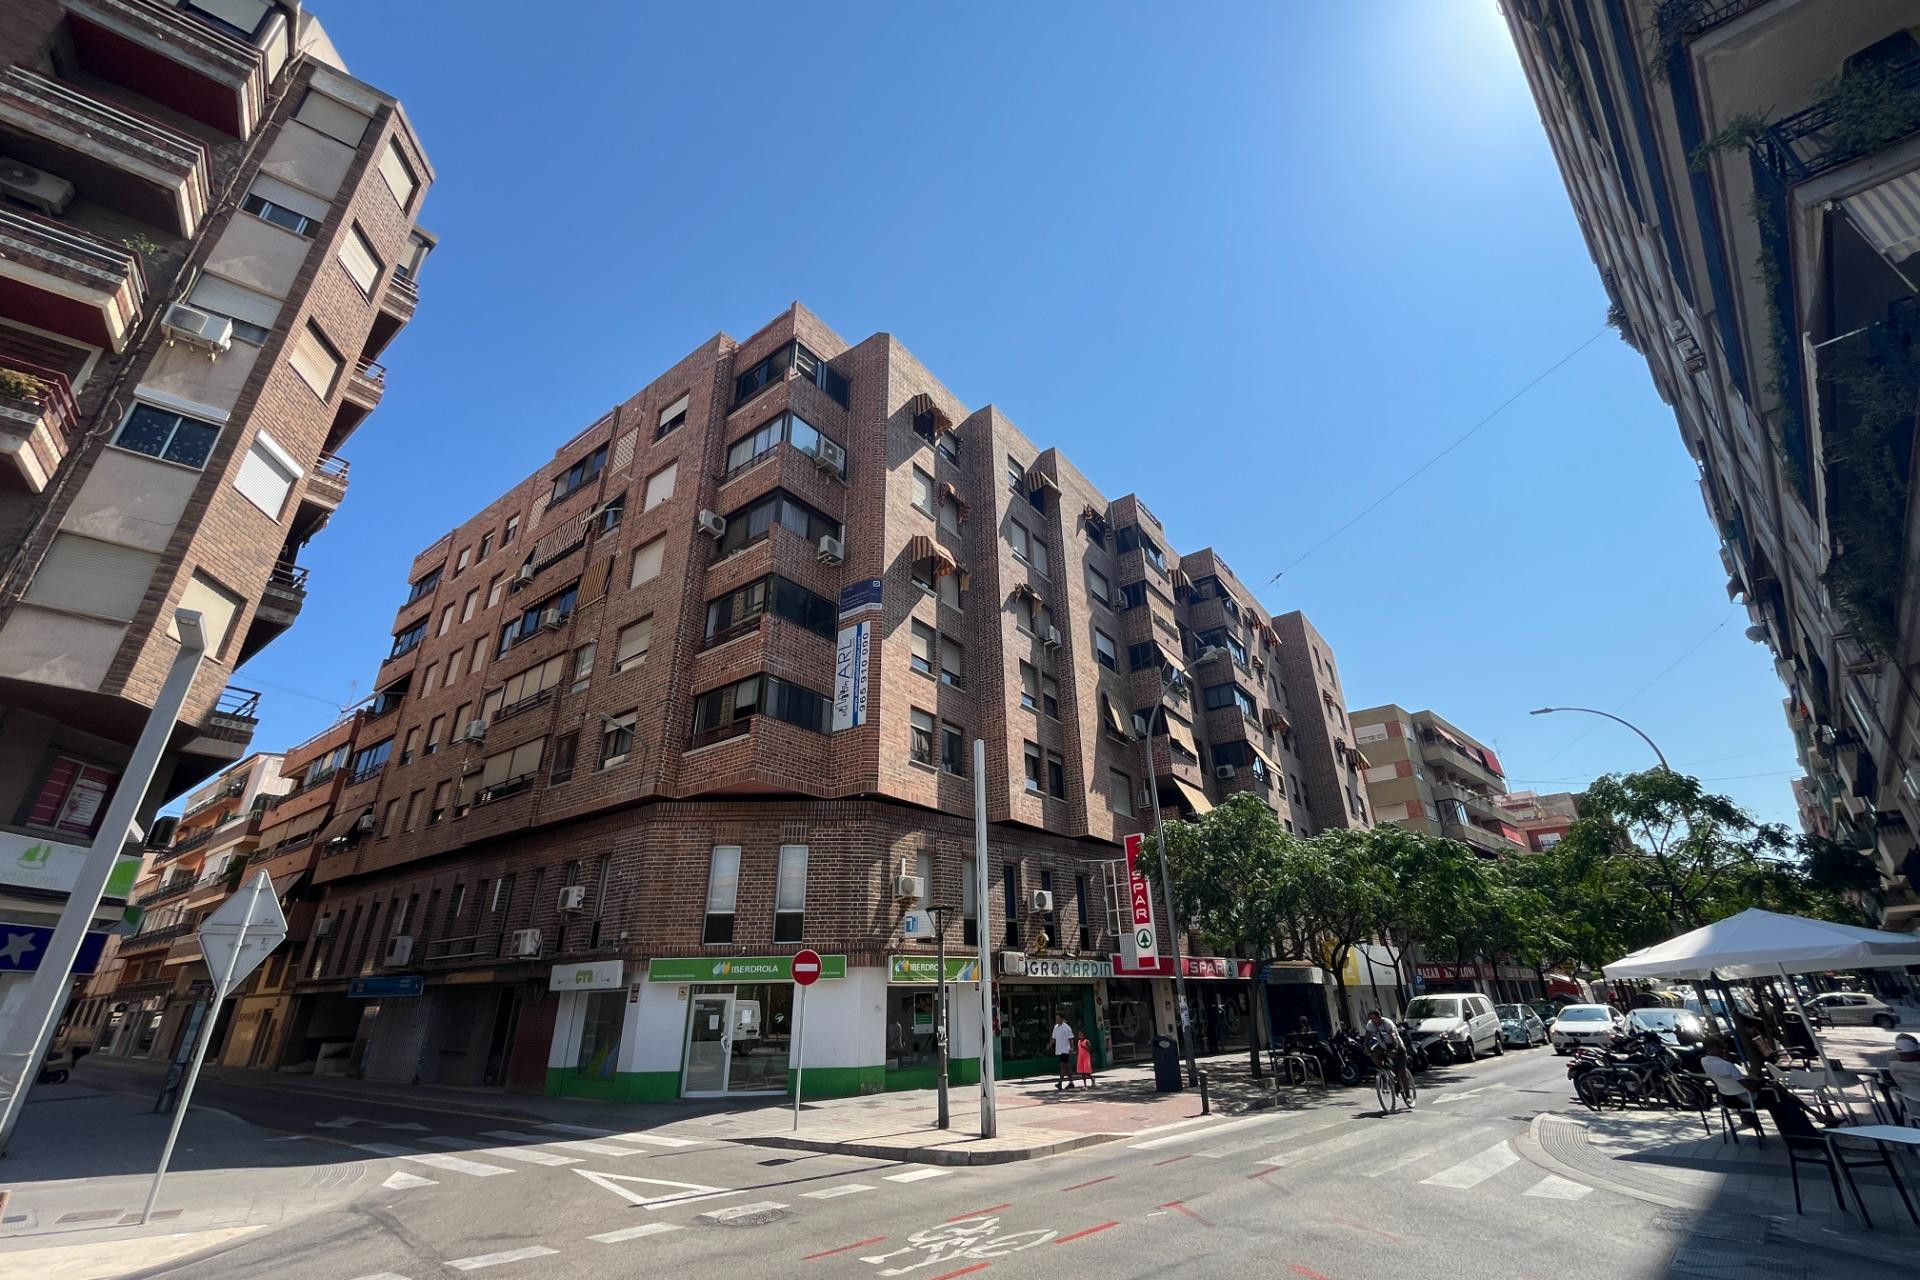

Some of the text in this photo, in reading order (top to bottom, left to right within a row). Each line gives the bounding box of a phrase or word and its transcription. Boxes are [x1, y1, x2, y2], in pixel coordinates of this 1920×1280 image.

[837, 638, 853, 679] ARL
[860, 660, 868, 684] 910
[859, 687, 867, 712] 965
[1131, 870, 1148, 920] SPAR
[731, 964, 779, 974] IBERDROLA
[910, 963, 947, 972] IBERDRO
[1063, 962, 1112, 977] JARDIN
[1190, 961, 1225, 975] SPAR
[1416, 967, 1441, 979] BAZAR
[1416, 975, 1423, 985] P
